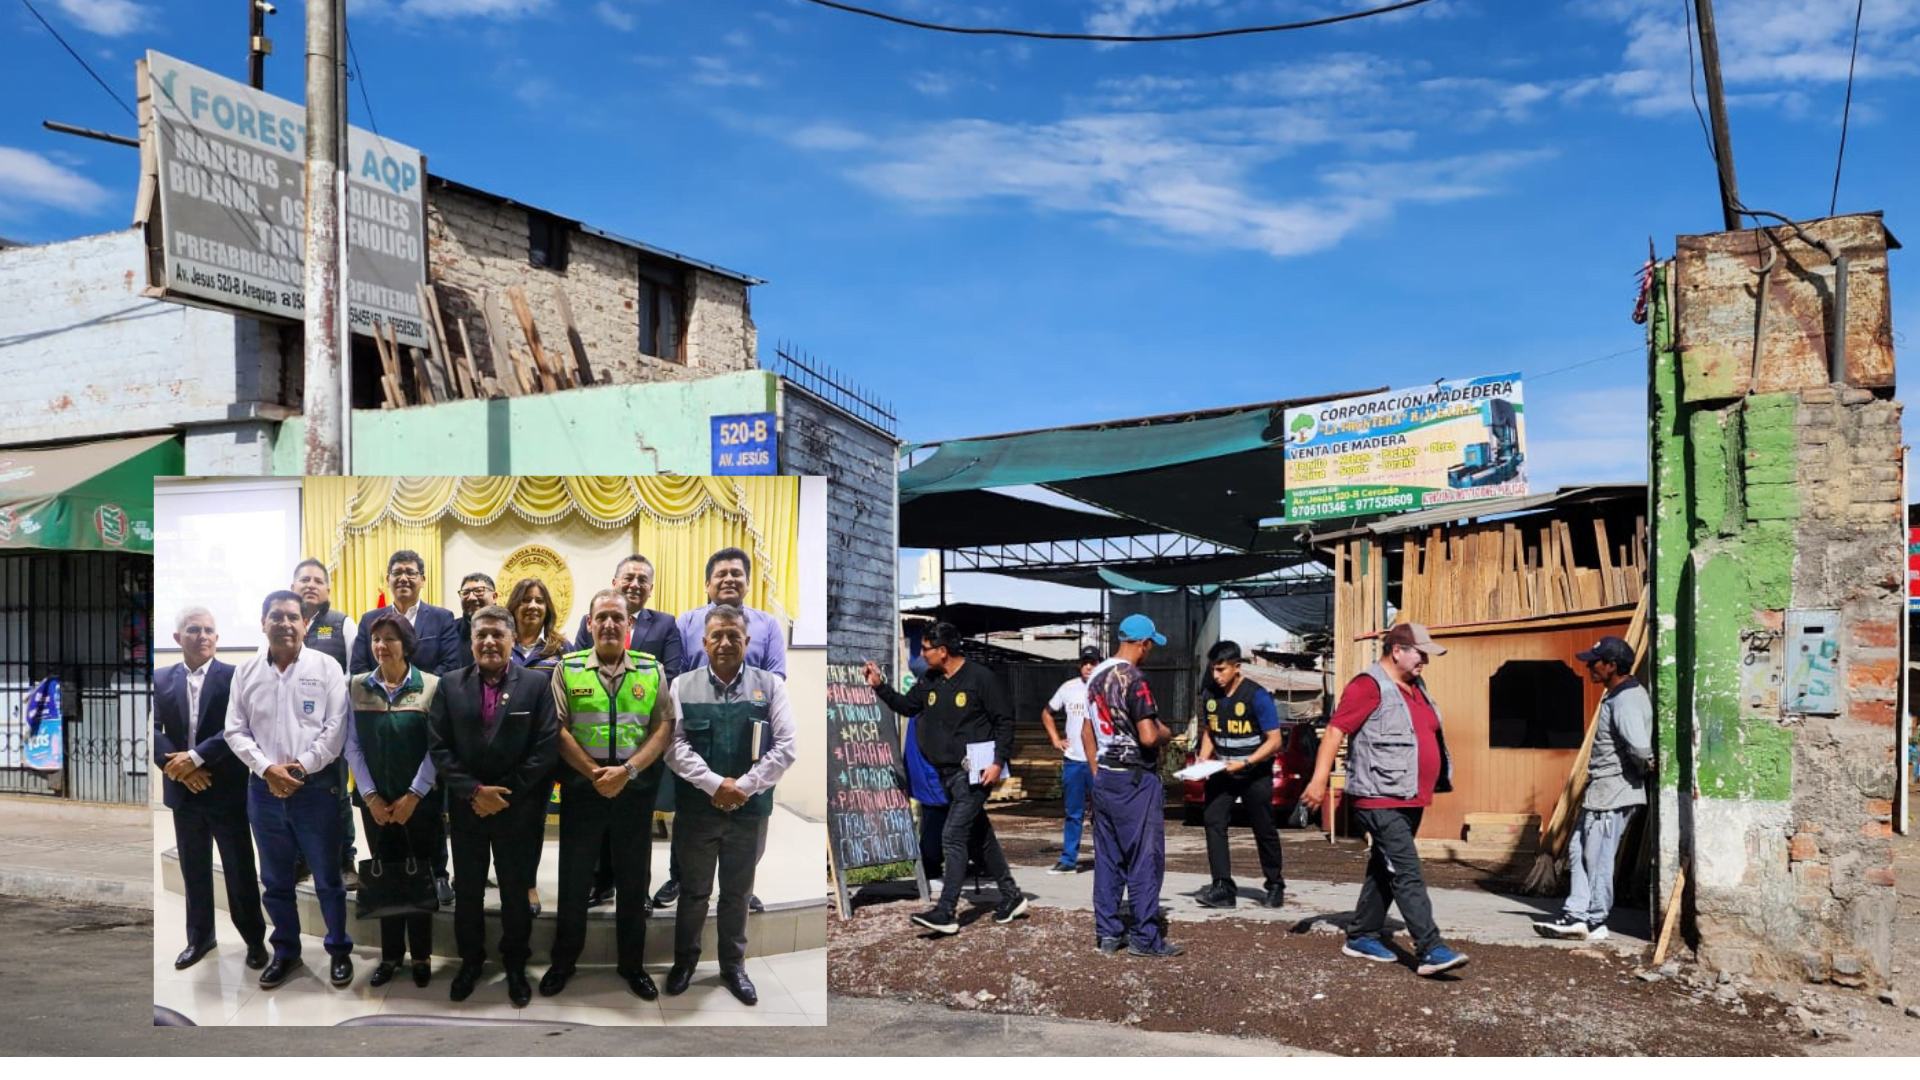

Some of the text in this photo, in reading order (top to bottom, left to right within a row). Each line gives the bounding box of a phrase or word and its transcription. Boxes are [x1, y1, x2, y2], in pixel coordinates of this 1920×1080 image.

[174, 126, 280, 190] MADERAS
[361, 149, 417, 194] AQP
[168, 159, 261, 217] BOLAINA
[280, 194, 305, 230] OS
[349, 216, 418, 263] ENOLICO
[174, 230, 419, 316] PREFABRICADO RPINTERIA
[176, 262, 190, 282] Av.
[191, 266, 216, 289] Jesus
[217, 273, 241, 295] 520-B
[242, 279, 277, 306] Arequipa
[1320, 393, 1423, 422] CORPORACIÓN
[1427, 382, 1514, 405] MADEDERA
[720, 420, 767, 445] 520-B
[719, 448, 769, 467] AV. JESÚS
[1290, 434, 1406, 460] VENTA DE MADERA
[1291, 501, 1347, 517] 970510346
[1355, 493, 1413, 511] 977528609
[1335, 490, 1359, 500] 520-B
[506, 547, 563, 569] POLICIA NACIONAL
[520, 557, 532, 566] DEL
[849, 721, 880, 742] MISA
[834, 812, 878, 837] TABLAS
